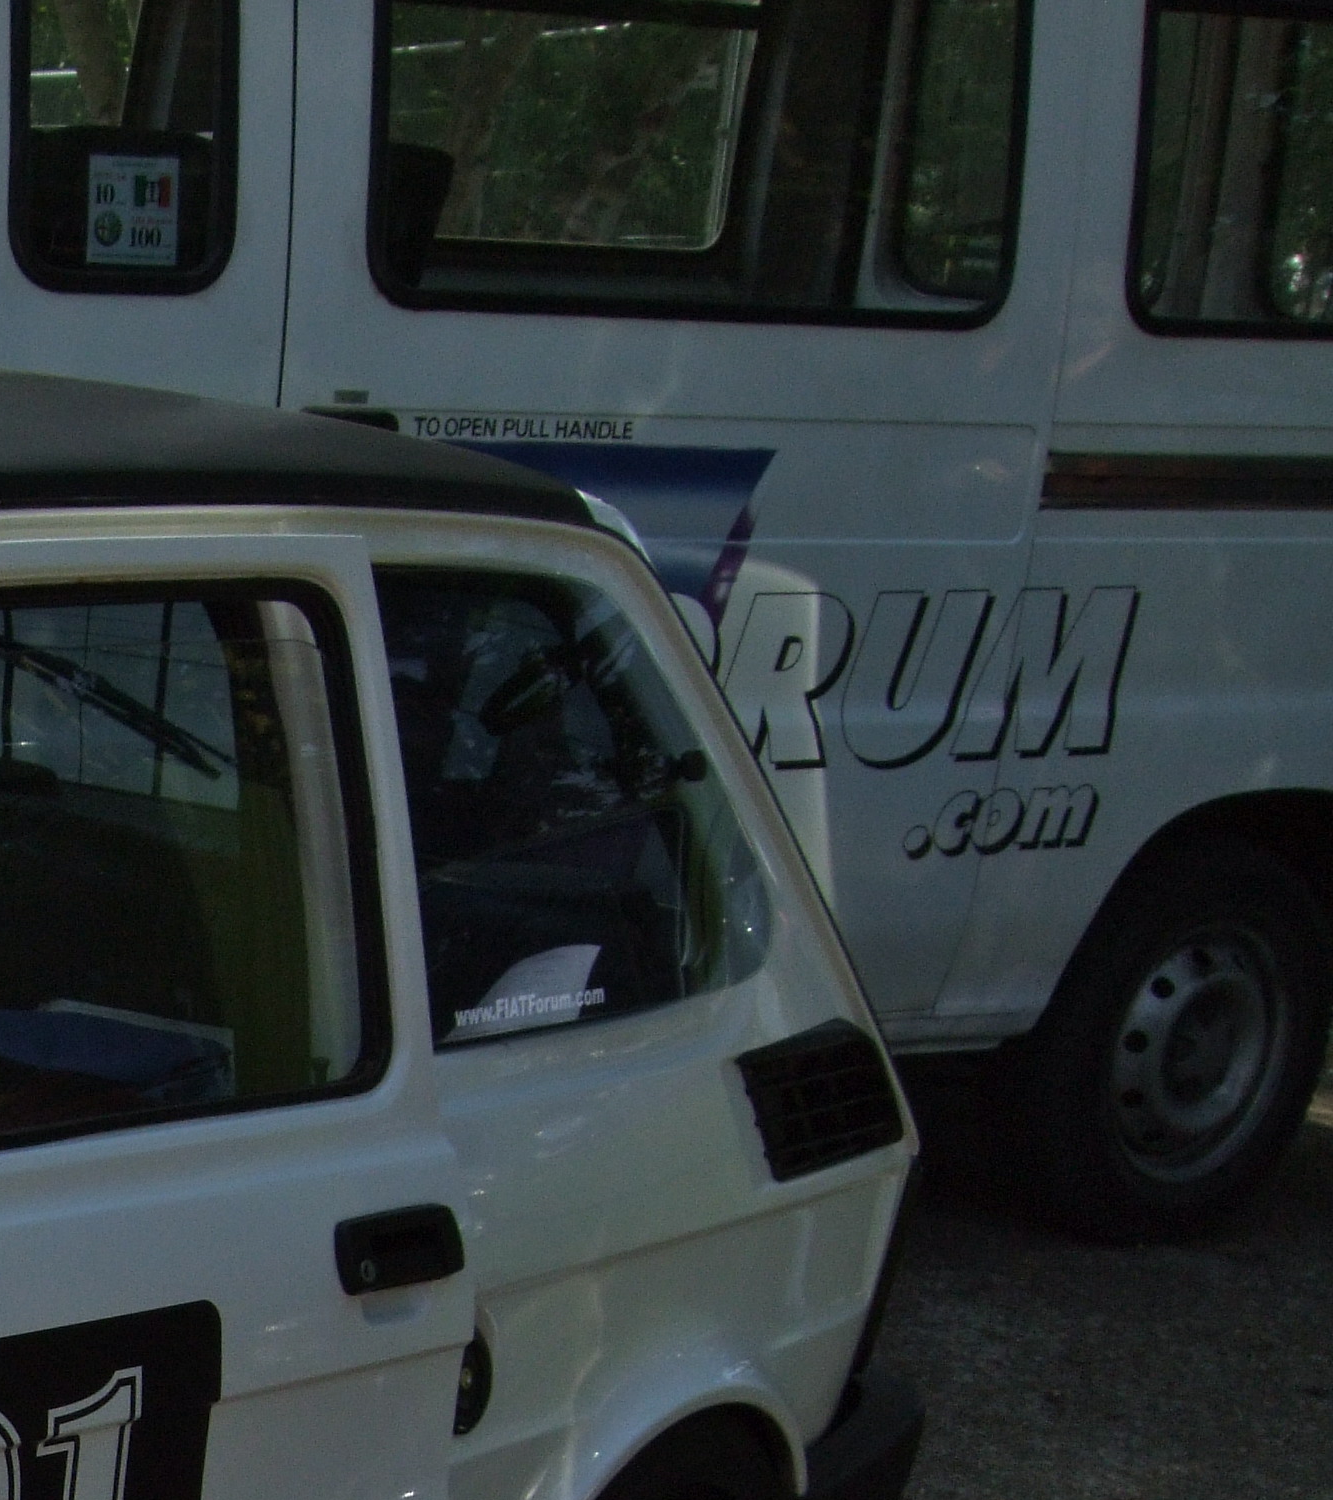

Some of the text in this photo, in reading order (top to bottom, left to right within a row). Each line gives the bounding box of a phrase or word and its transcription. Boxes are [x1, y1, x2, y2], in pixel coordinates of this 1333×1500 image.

[414, 416, 634, 440] TO OPEN PULL HANDLE
[674, 585, 1141, 770] RUM
[903, 783, 1100, 860] .com
[454, 987, 606, 1028] www.FIATForum.com
